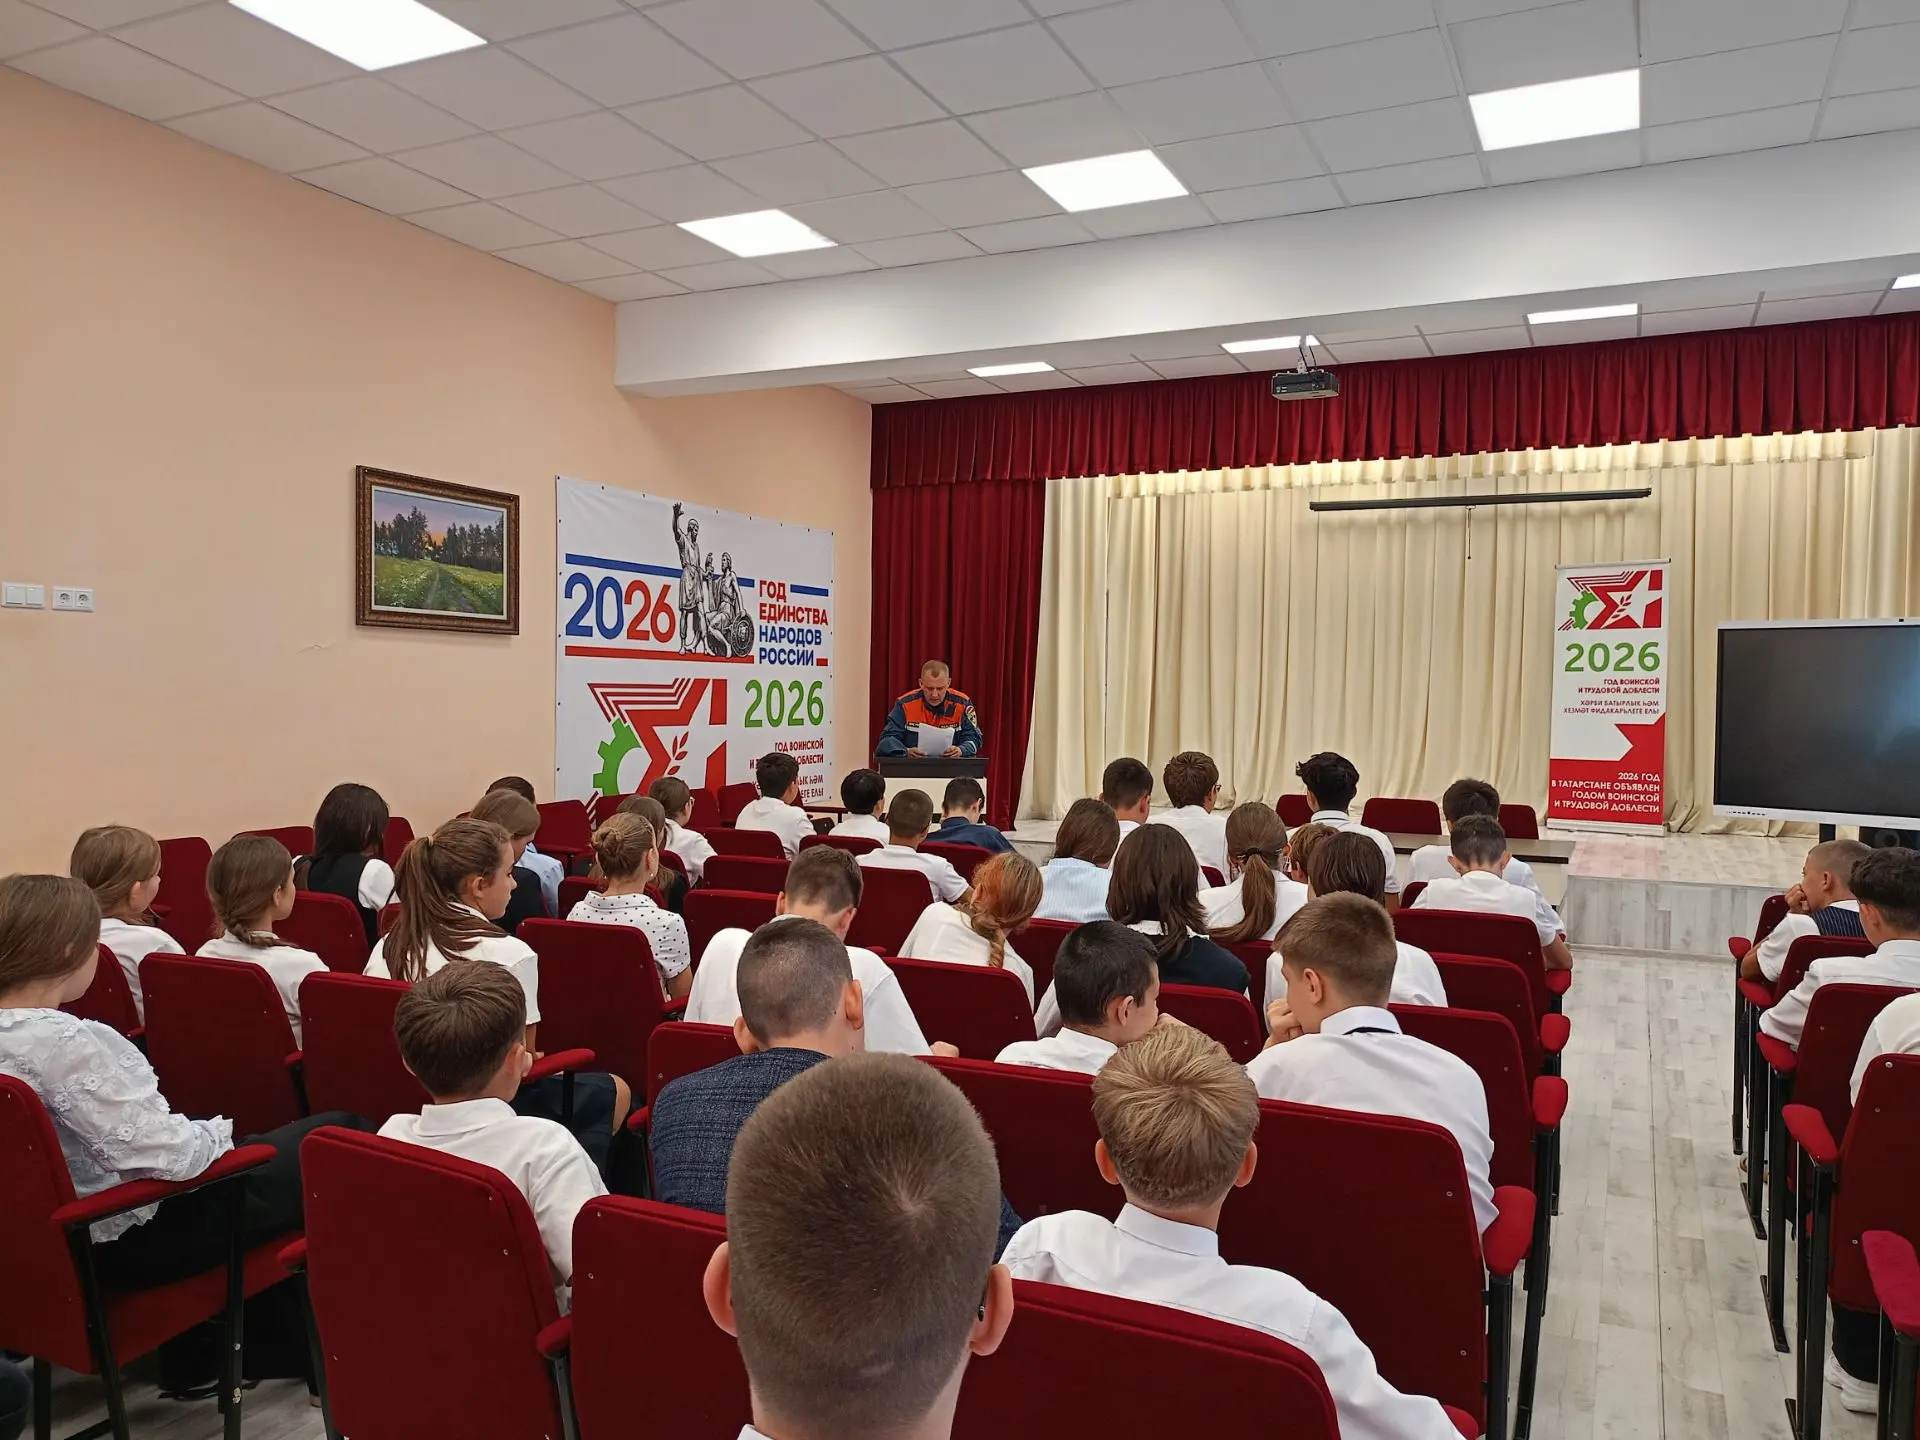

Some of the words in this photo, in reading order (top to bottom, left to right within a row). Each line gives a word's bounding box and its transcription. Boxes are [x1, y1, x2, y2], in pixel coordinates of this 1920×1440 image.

[759, 580, 787, 603] ГОД
[565, 573, 676, 643] 2026
[759, 603, 829, 626] ЕДИНСТВА
[759, 626, 822, 647] НАРОДОВ
[759, 648, 814, 666] РОССИИ
[1565, 642, 1660, 672] 2026
[745, 679, 824, 728] 2026
[775, 742, 788, 752] ГОД
[790, 738, 824, 751] ВОИНСКОЙ
[750, 759, 754, 769] И
[1559, 780, 1611, 790] ТАТАРСТАНЕ
[1613, 783, 1660, 792] ОБЪЯВЛЕН
[1618, 772, 1639, 780] 2026
[1641, 773, 1660, 782] ГОД
[1572, 791, 1605, 800] ГОДОМ
[1608, 792, 1660, 802] ВОИНСКОЙ
[1562, 800, 1609, 810] ТРУДОВОЙ
[1611, 803, 1660, 813] ДОБЛЕСТИ
